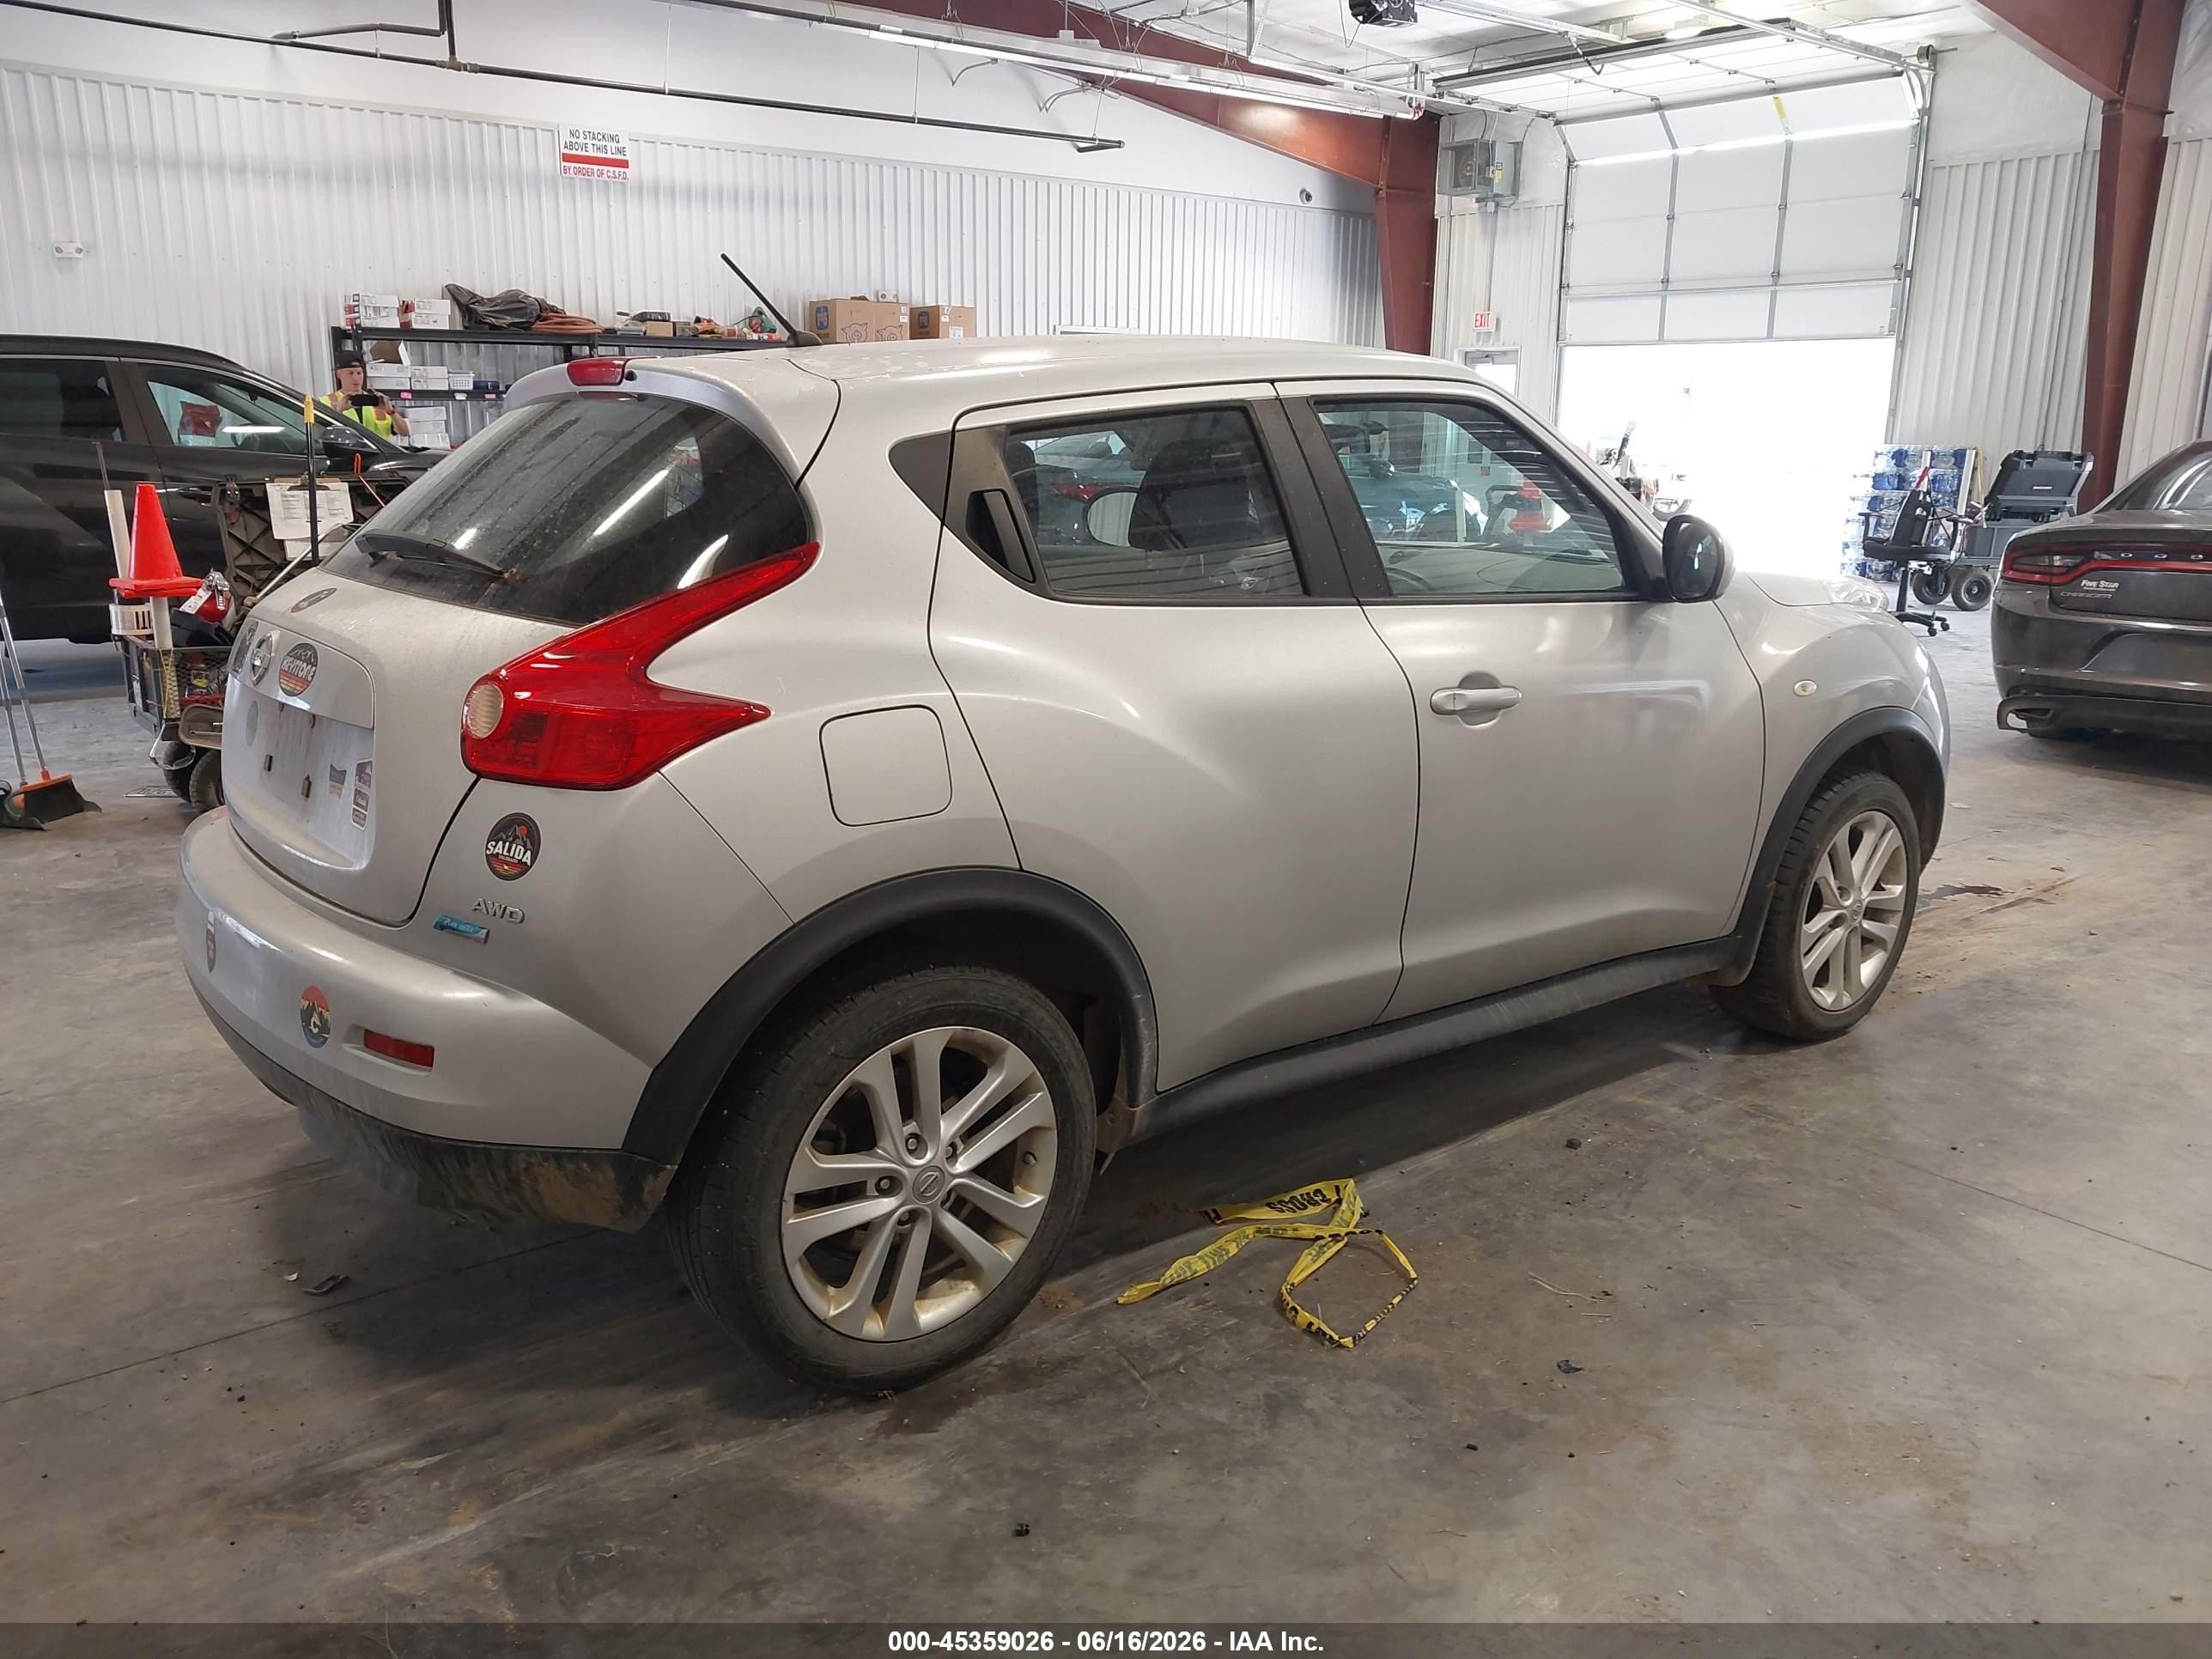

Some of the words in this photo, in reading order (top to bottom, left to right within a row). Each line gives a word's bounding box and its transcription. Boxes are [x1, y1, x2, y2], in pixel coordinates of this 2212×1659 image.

[569, 129, 580, 139] NO
[583, 131, 620, 143] STACKING
[563, 141, 589, 152] ABOVE
[591, 143, 608, 155] THIS
[611, 145, 627, 156] LINE
[563, 165, 571, 174] BY
[573, 167, 595, 177] ORDER
[596, 168, 605, 178] OF
[606, 169, 629, 180] C.S.F.D.
[1474, 313, 1491, 327] EXIT
[486, 840, 532, 866] SALIDA
[471, 898, 525, 924] AWD
[1265, 1188, 1331, 1214] CROSS
